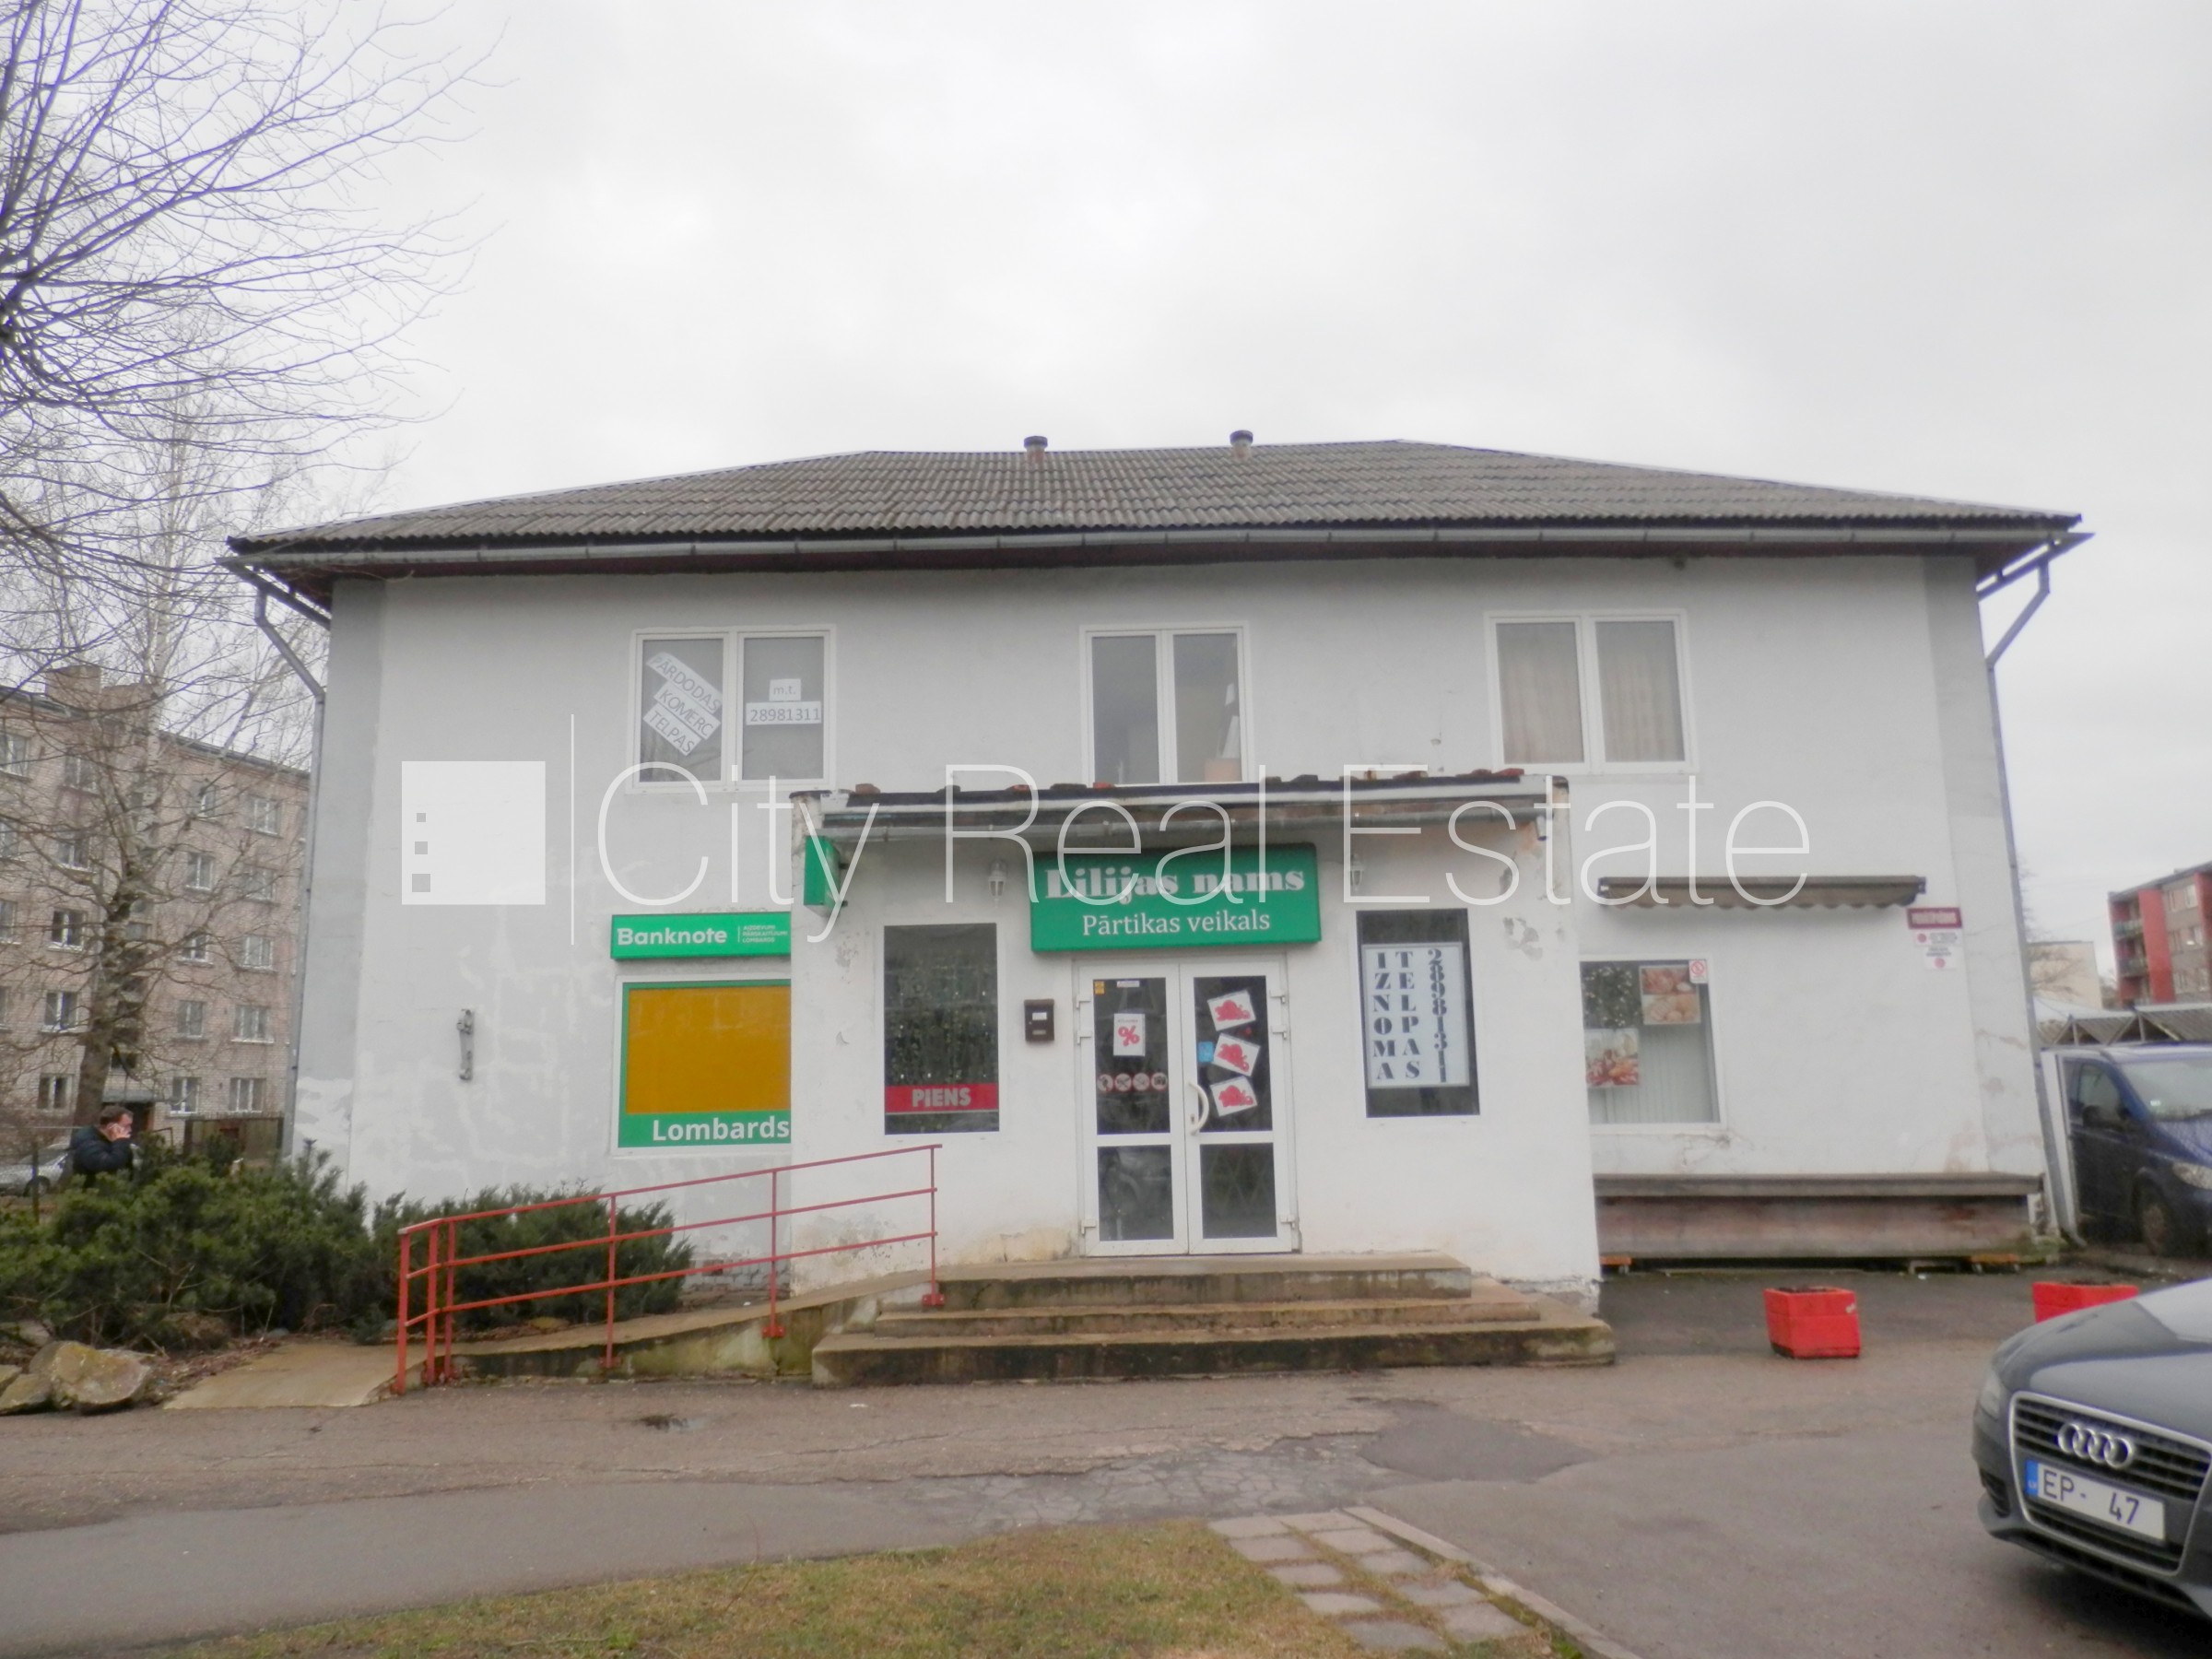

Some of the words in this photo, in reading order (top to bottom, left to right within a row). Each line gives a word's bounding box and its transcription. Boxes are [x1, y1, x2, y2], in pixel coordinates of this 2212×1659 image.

[652, 656, 723, 711] PĀRDODAS
[772, 686, 796, 695] m.t.
[659, 688, 713, 737] KOMERC
[749, 708, 820, 722] 28981311
[649, 711, 695, 754] TELPAS
[1045, 866, 1179, 904] Lilijas
[1194, 870, 1305, 893] nams
[1083, 912, 1181, 936] Pārtikas
[1187, 909, 1270, 932] veikals
[617, 927, 727, 946] Banknote
[912, 1087, 971, 1108] PIENS
[653, 1115, 790, 1142] Lombards
[2109, 1491, 2140, 1524] 47
